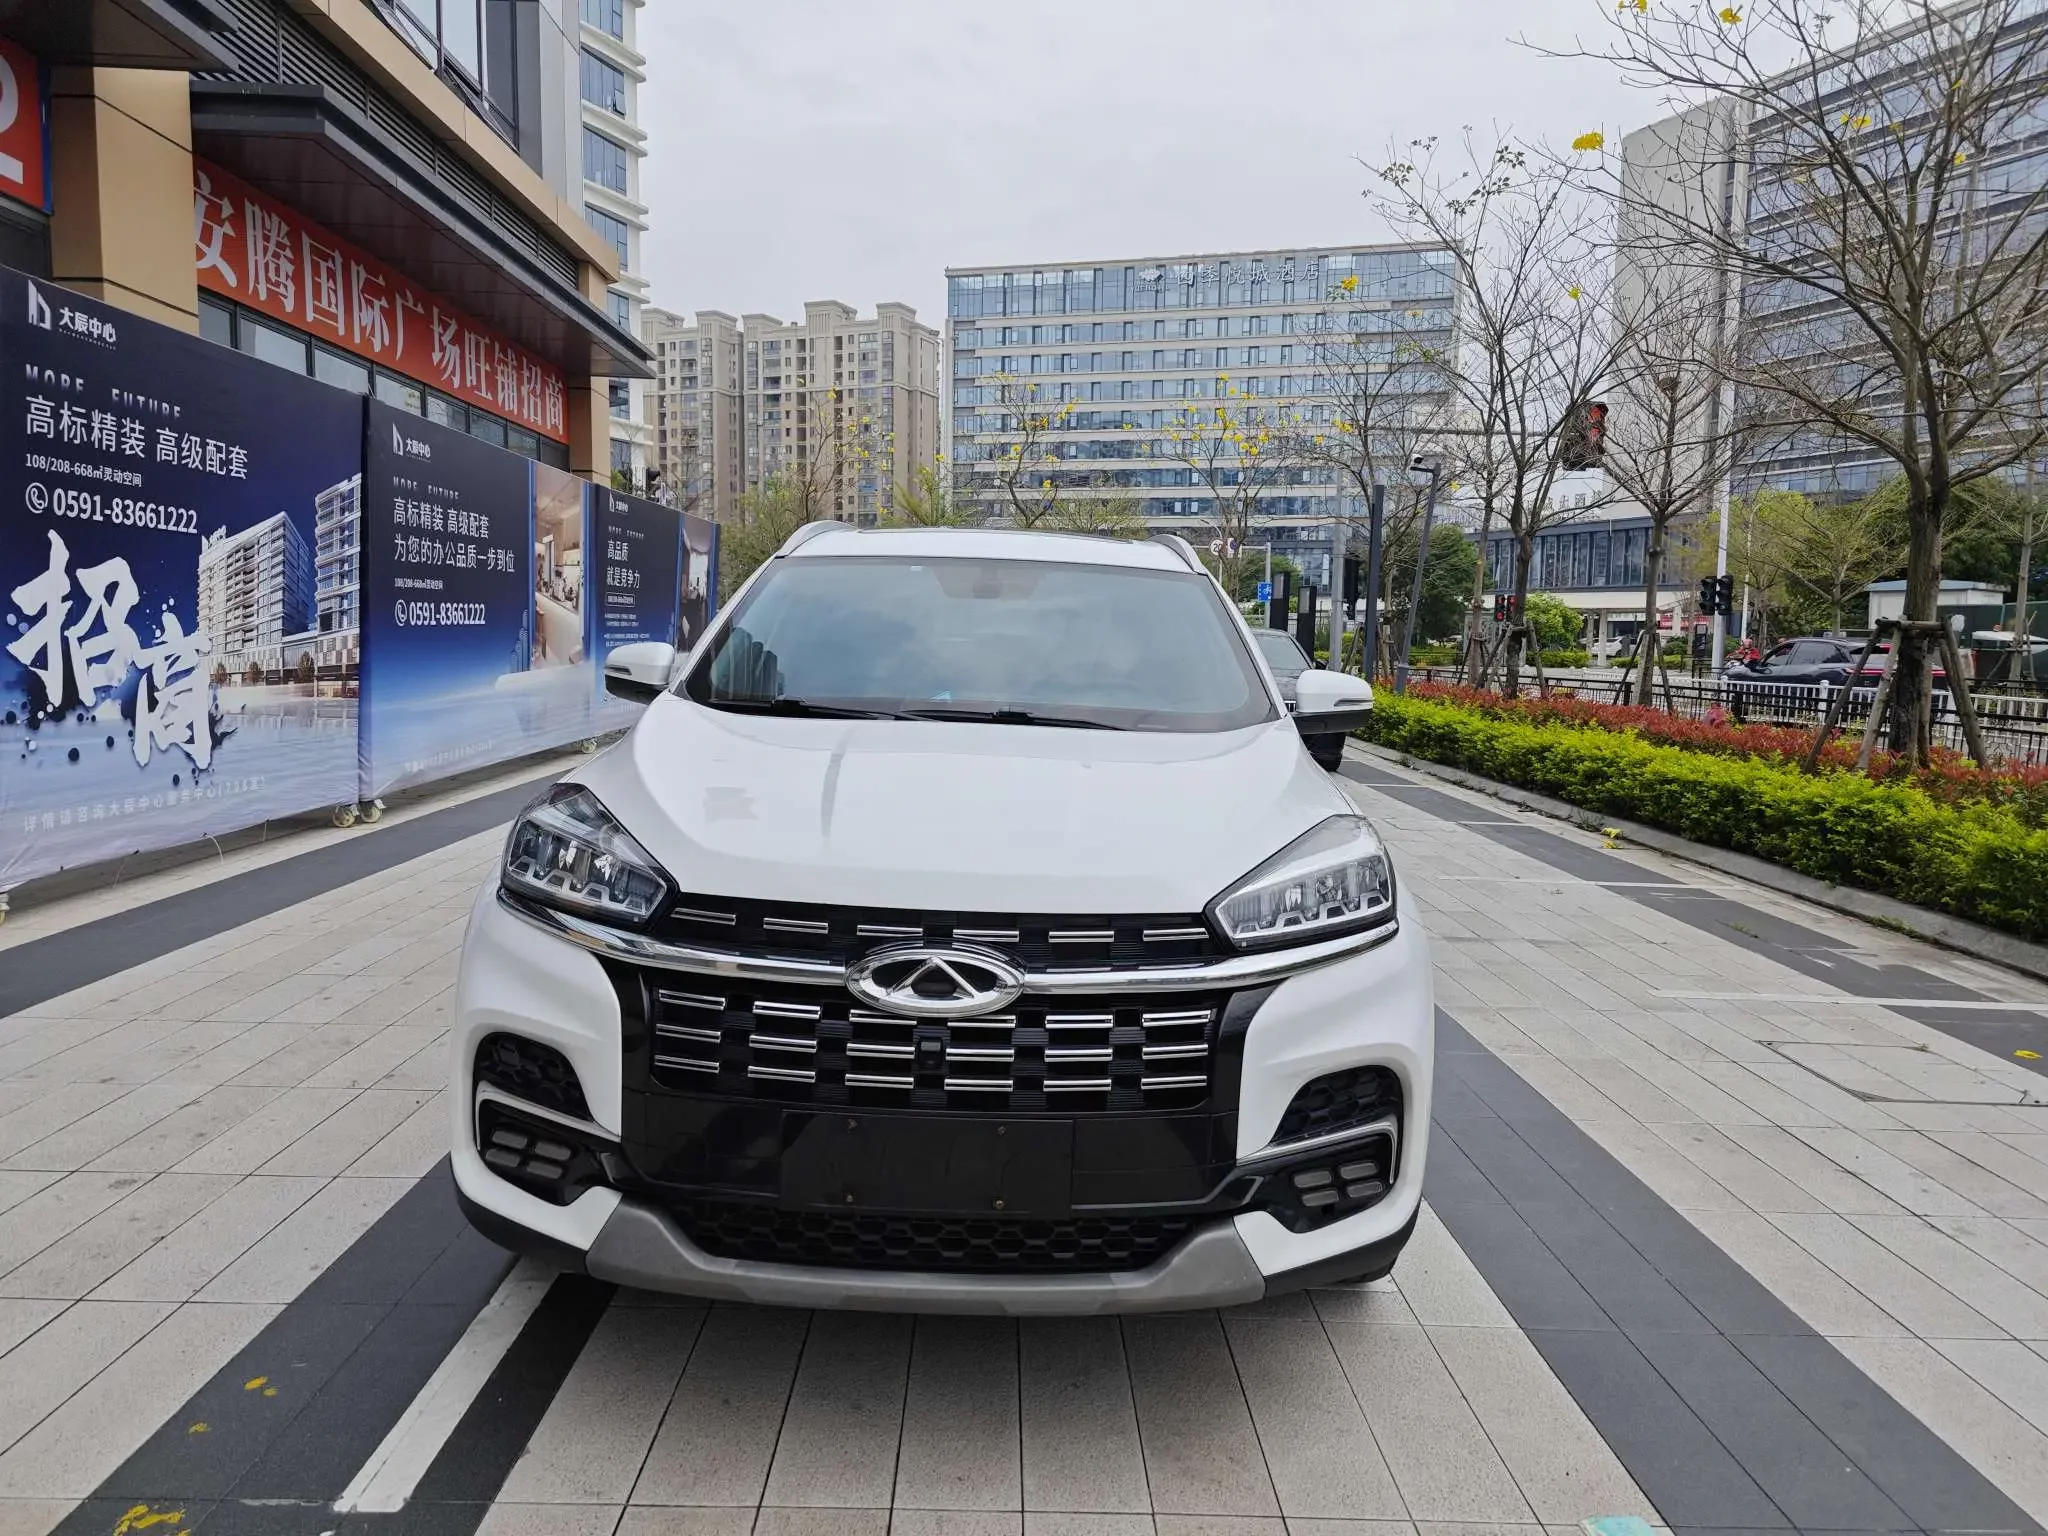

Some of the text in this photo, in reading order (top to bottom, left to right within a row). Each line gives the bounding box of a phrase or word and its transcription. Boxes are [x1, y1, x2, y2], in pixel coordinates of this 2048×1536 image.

[1177, 261, 1319, 287] 四季悦城酒店
[195, 168, 564, 436] 安腾国际广场旺铺招商
[59, 306, 117, 344] 大辰中心
[26, 395, 249, 480] 高标精装 高级配套
[53, 487, 199, 535] 0591-83661222
[393, 497, 490, 540] 高标精装 高级配套
[394, 533, 515, 572] 为您的办公品质一步到位
[607, 540, 629, 562] 高品质
[409, 602, 486, 626] 0591-83661222
[6, 528, 212, 770] 招商
